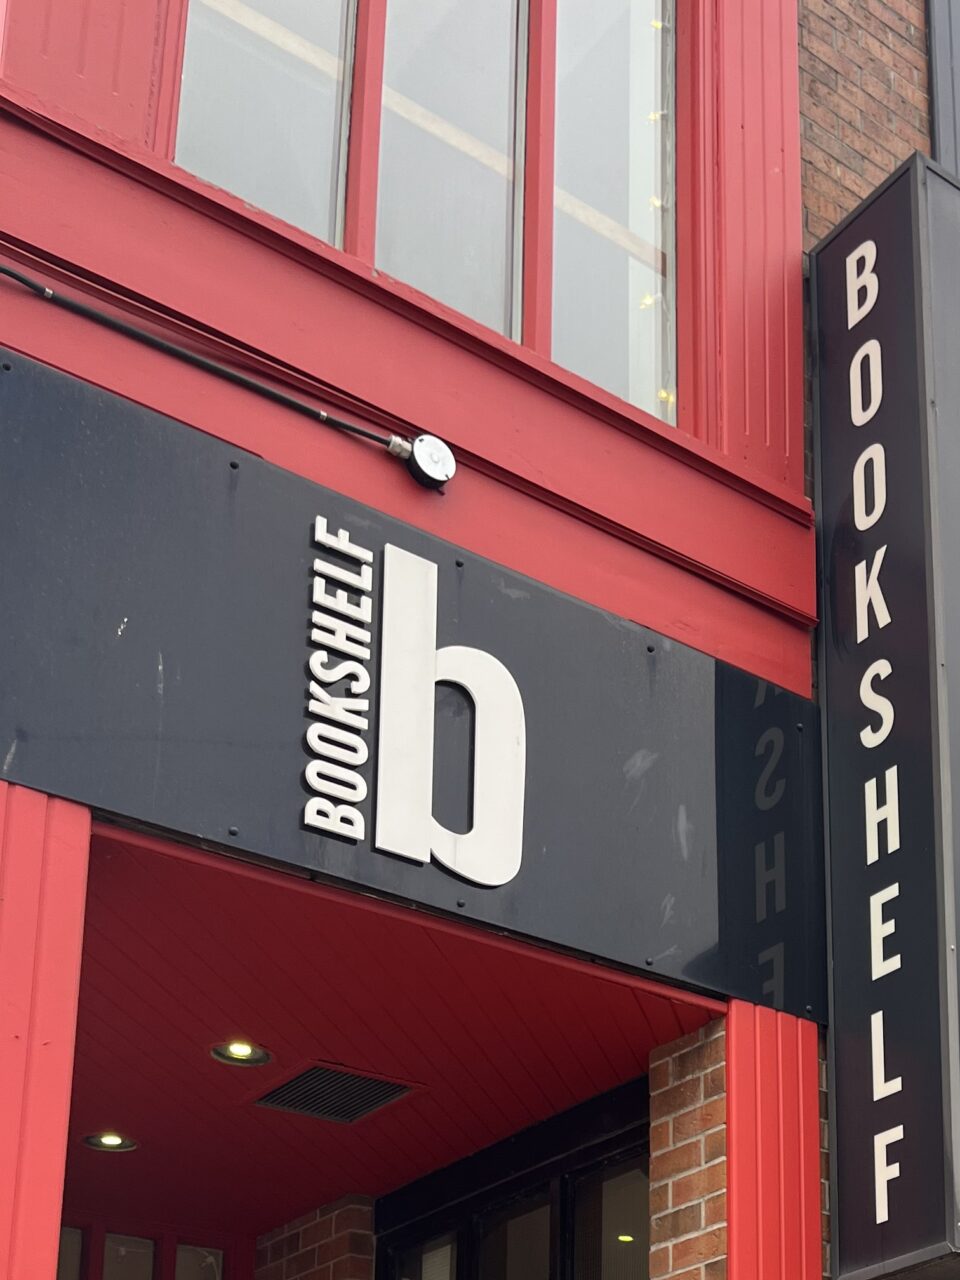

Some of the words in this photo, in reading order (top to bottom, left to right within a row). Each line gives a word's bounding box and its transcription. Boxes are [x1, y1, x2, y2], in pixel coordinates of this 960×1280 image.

[304, 515, 373, 841] BOOKSHELF
[375, 543, 526, 886] b
[845, 240, 904, 1224] BOOKSHELF
